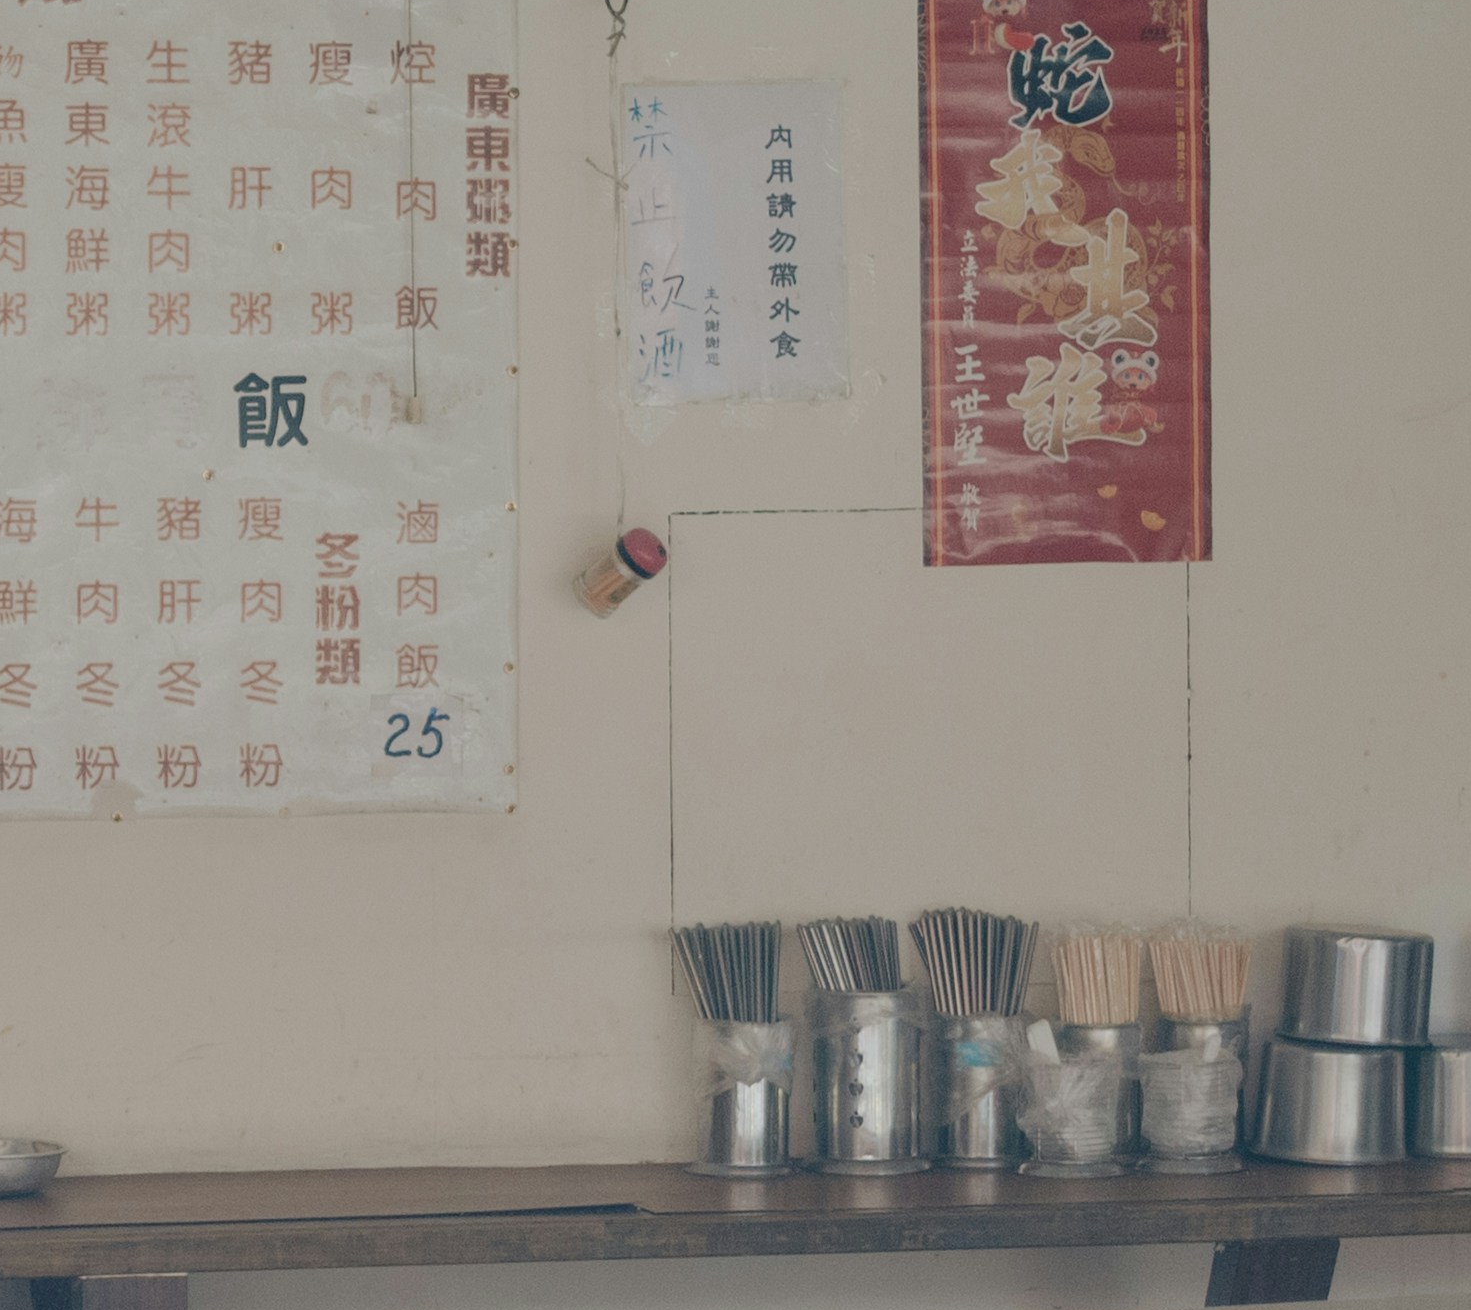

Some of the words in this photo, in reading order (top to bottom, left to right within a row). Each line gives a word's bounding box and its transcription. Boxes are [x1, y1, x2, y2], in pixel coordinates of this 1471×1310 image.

[66, 39, 108, 333] 廣東海鮮粥
[147, 41, 190, 333] 生滾牛肉粥
[463, 74, 511, 278] 廣東粥類
[627, 96, 696, 382] 禁止飲酒
[764, 124, 800, 359] 內用請勿帶外食
[959, 230, 981, 330] 立法委員
[233, 373, 308, 448] 飯
[951, 343, 990, 467] 王世堅
[76, 499, 119, 789] 牛肉冬粉
[158, 499, 201, 788] 豬肝冬粉
[240, 498, 283, 787] 瘦肉冬粉
[317, 534, 359, 683] 冬粉類
[397, 501, 440, 687] 滷肉飯
[384, 707, 450, 759] 25
